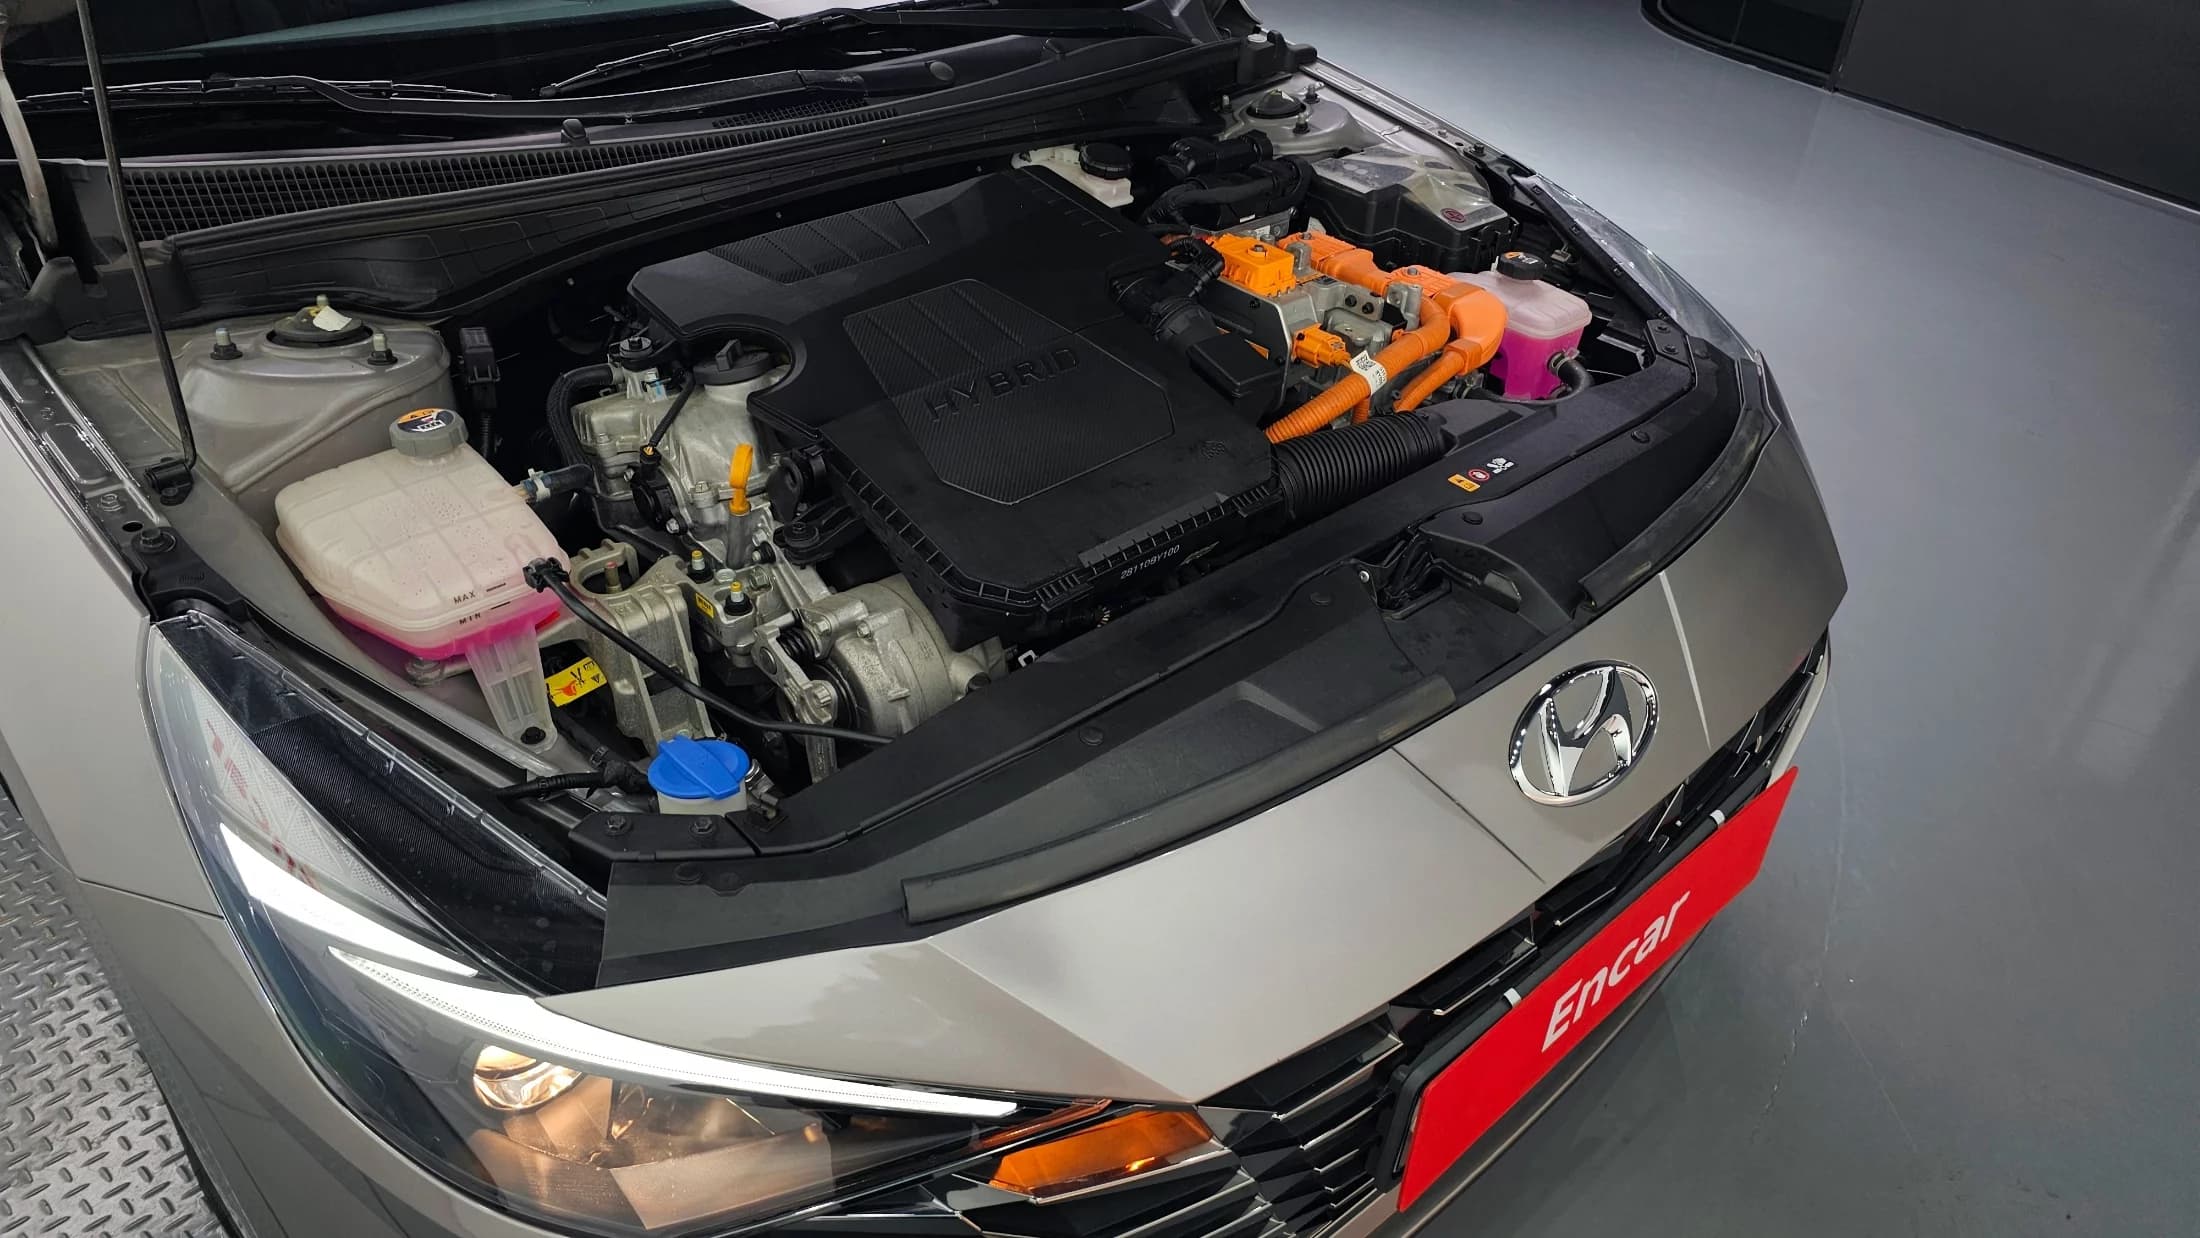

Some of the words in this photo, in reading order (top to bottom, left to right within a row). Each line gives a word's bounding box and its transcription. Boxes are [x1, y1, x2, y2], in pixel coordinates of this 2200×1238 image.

[924, 349, 1079, 423] HYBRID
[453, 590, 476, 604] MAX
[1541, 890, 1691, 1053] Encar
